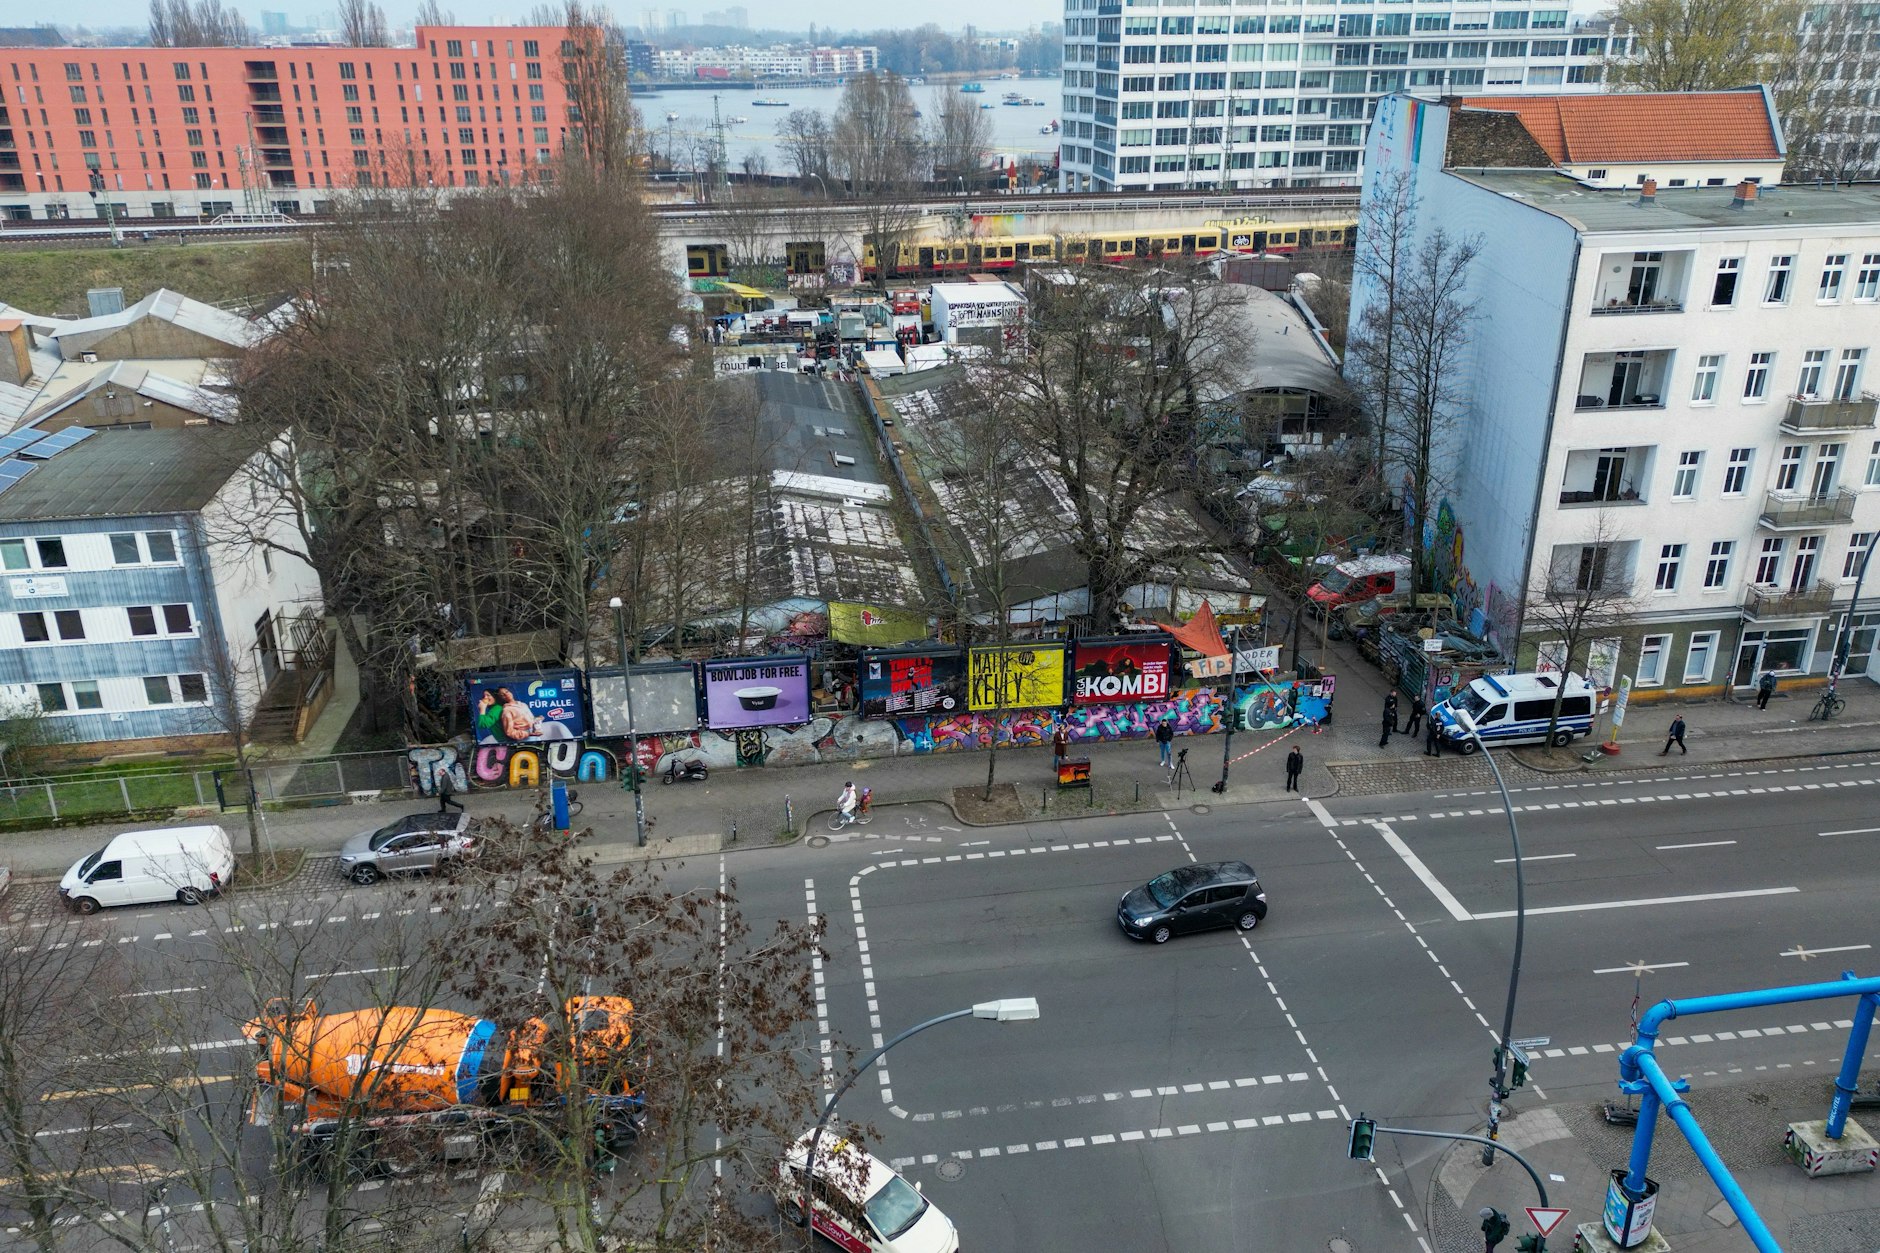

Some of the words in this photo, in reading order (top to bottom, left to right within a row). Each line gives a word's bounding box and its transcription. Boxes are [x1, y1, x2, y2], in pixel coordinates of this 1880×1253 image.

[711, 668, 757, 682] BOWLJOB
[760, 668, 777, 679] FOR
[779, 666, 803, 678] FREE.
[1199, 658, 1232, 674] FIP
[972, 672, 1023, 705] KELLY
[1076, 678, 1085, 697] GIGA
[1085, 673, 1166, 697] KOMBI
[529, 700, 548, 708] FÜR
[549, 699, 574, 708] ALLE.
